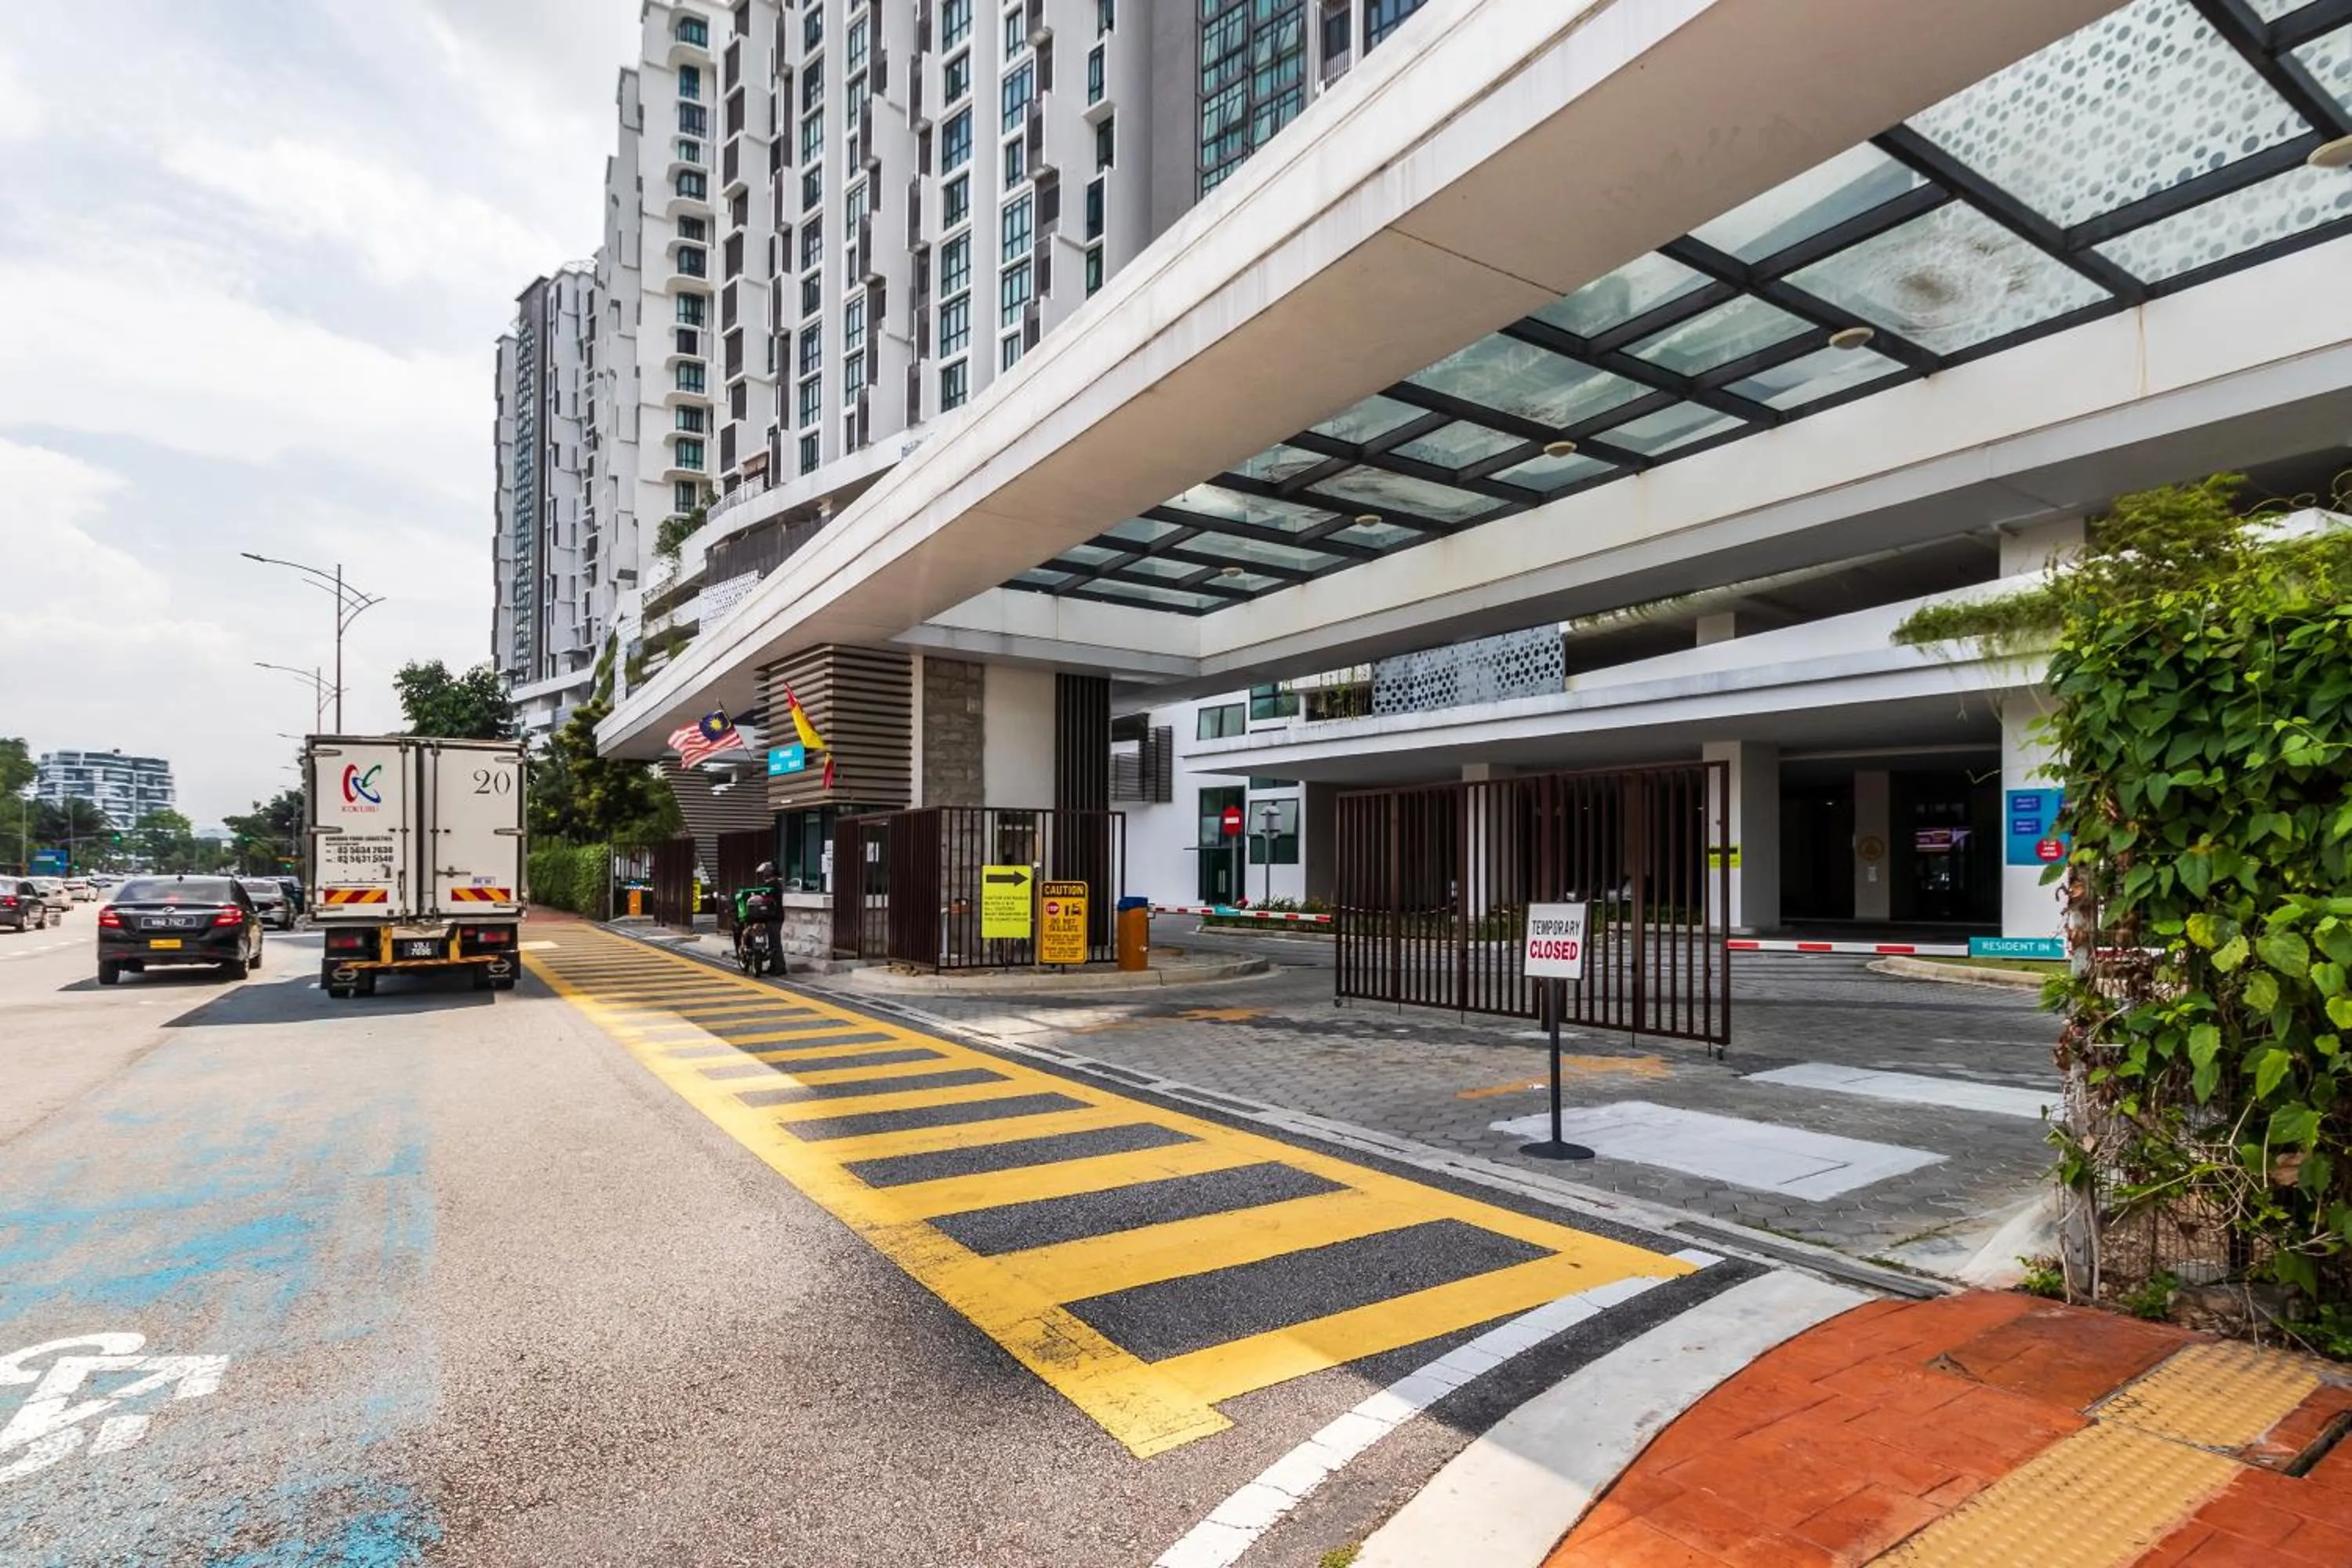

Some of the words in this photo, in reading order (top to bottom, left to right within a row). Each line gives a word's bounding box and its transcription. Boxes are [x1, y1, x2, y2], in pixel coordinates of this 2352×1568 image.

[473, 769, 511, 796] 20
[1044, 885, 1083, 895] CAUTION
[1531, 920, 1581, 937] TEMPORARY
[1530, 940, 1578, 961] CLOSED
[1982, 942, 2033, 952] RESIDENT
[2038, 942, 2050, 952] IN
